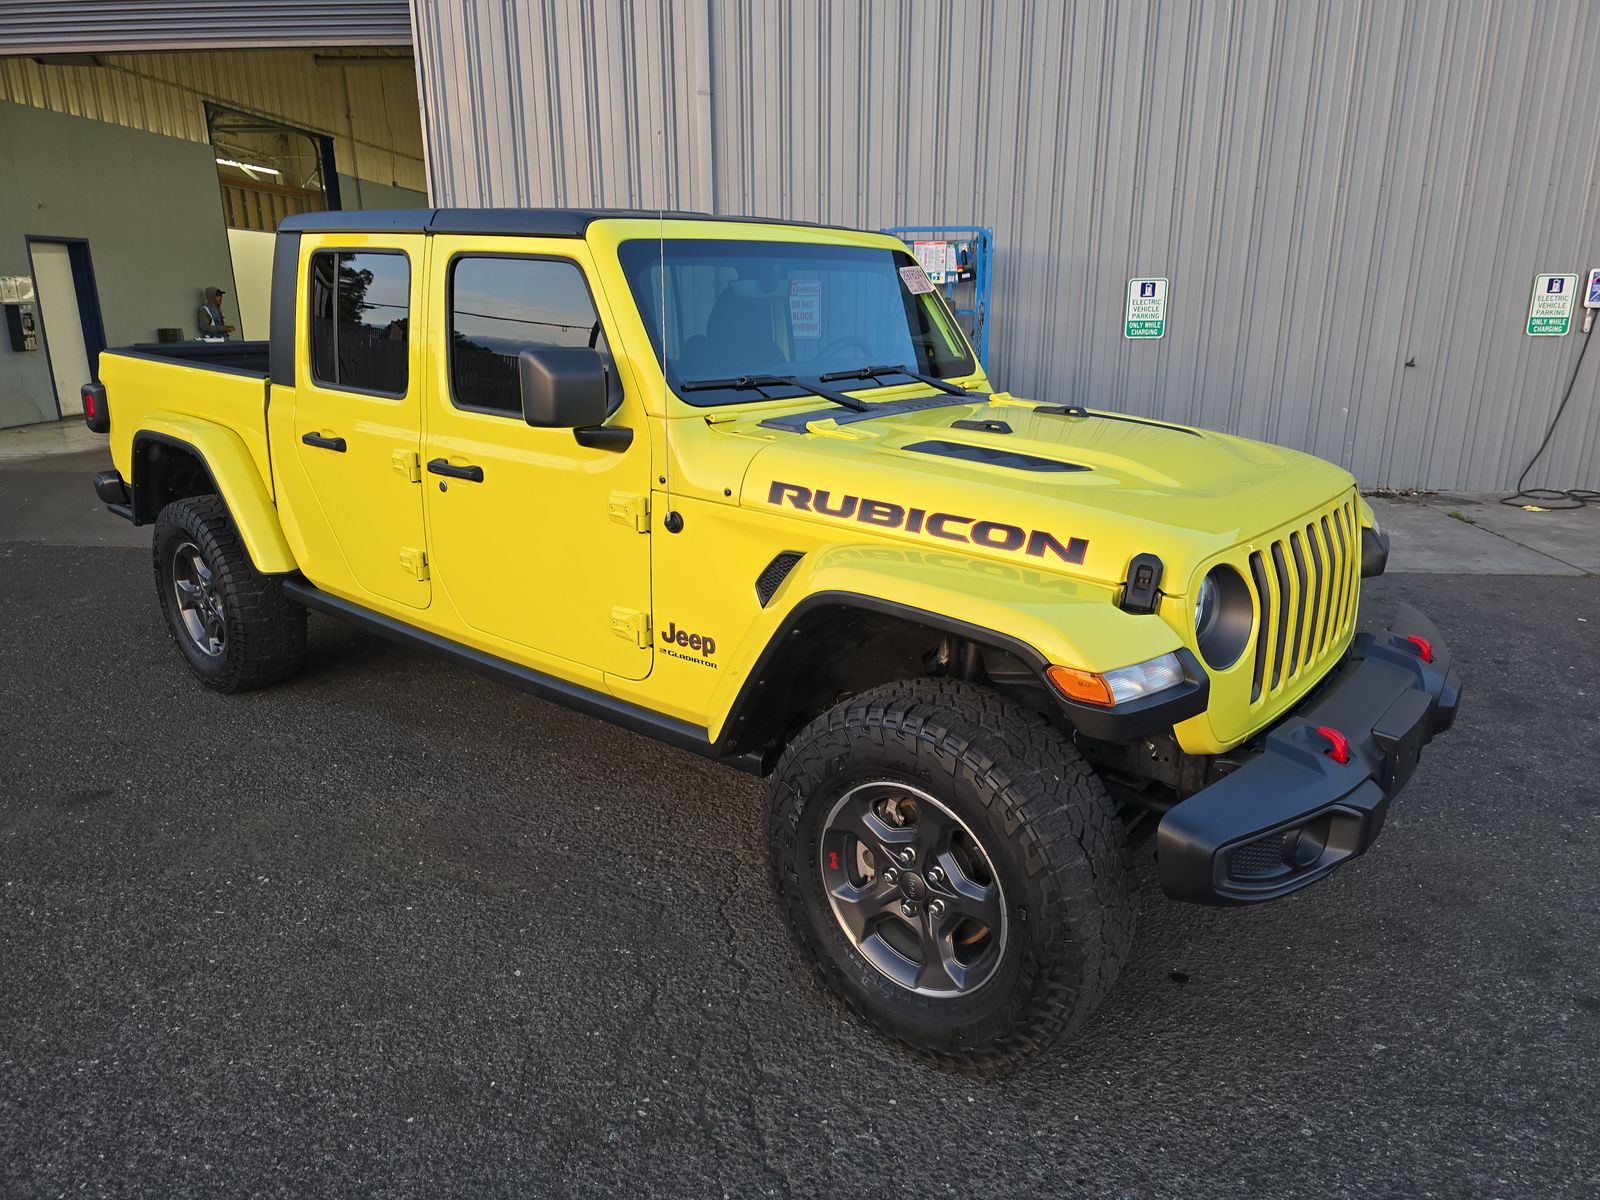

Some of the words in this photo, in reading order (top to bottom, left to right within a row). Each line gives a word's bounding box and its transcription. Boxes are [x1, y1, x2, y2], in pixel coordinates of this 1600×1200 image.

[802, 300, 815, 309] NOT
[792, 312, 814, 321] BLOCK
[1129, 321, 1143, 329] ONLY
[1144, 321, 1161, 329] WHILE
[1531, 318, 1547, 326] ONLY
[1548, 318, 1567, 326] WHILE
[767, 480, 1090, 565] RUBICON
[661, 621, 716, 658] Jeep
[667, 650, 718, 670] GLADIATOR
